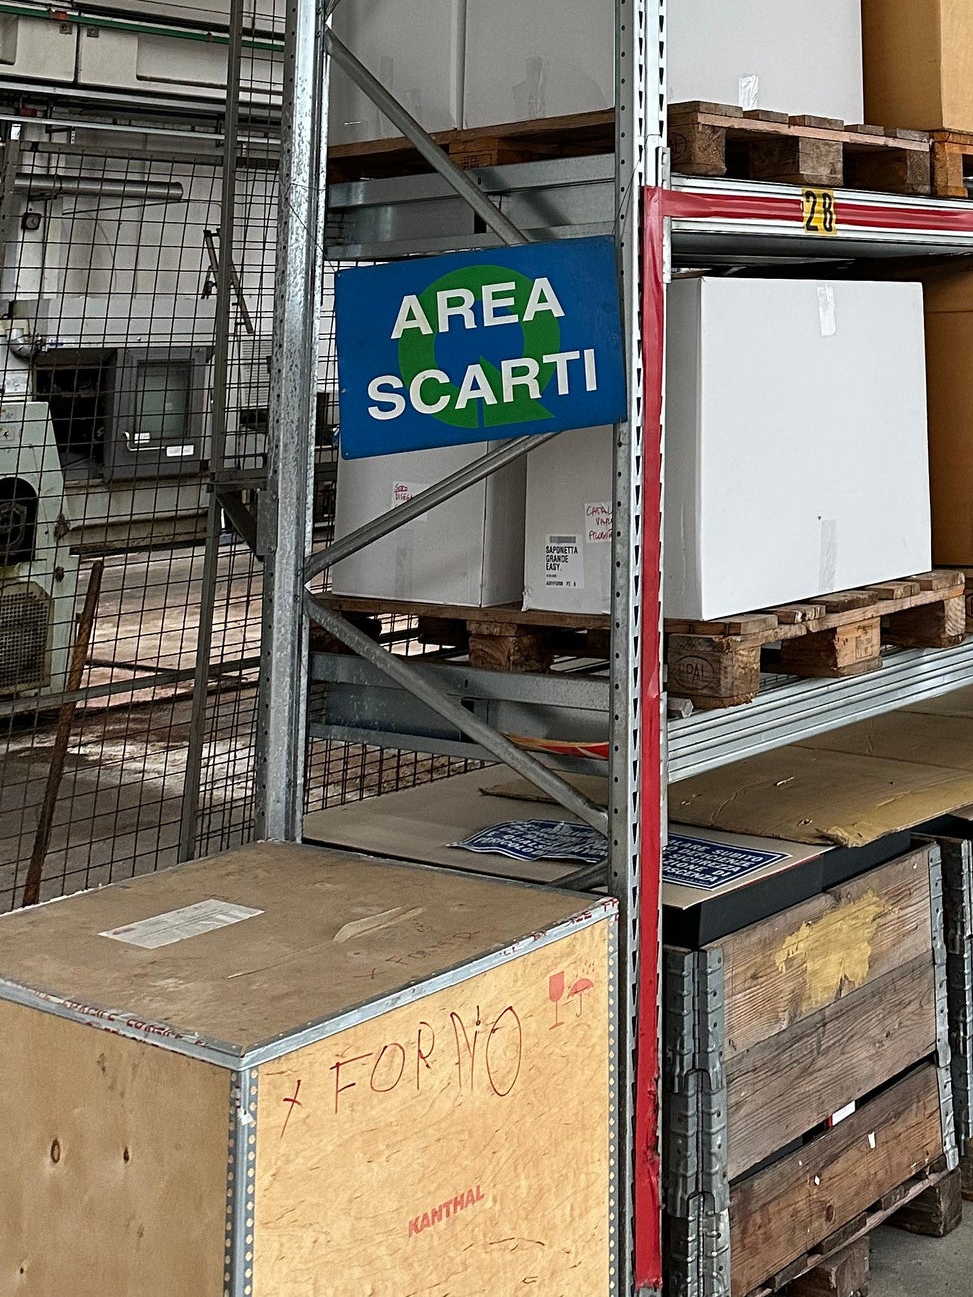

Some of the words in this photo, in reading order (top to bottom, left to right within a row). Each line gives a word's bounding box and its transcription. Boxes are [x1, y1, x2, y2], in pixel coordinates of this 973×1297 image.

[804, 191, 835, 233] 28
[390, 277, 565, 339] AREA
[368, 348, 597, 421] SCARTI
[546, 546, 578, 555] SAPONETTA
[546, 555, 569, 563] GRANDE
[669, 853, 741, 872] SICUREZZA
[682, 849, 755, 868] DEFICIENZE
[712, 850, 763, 862] SUBITO
[662, 865, 719, 883] OSCENZA
[407, 1184, 485, 1239] KANTHAL
